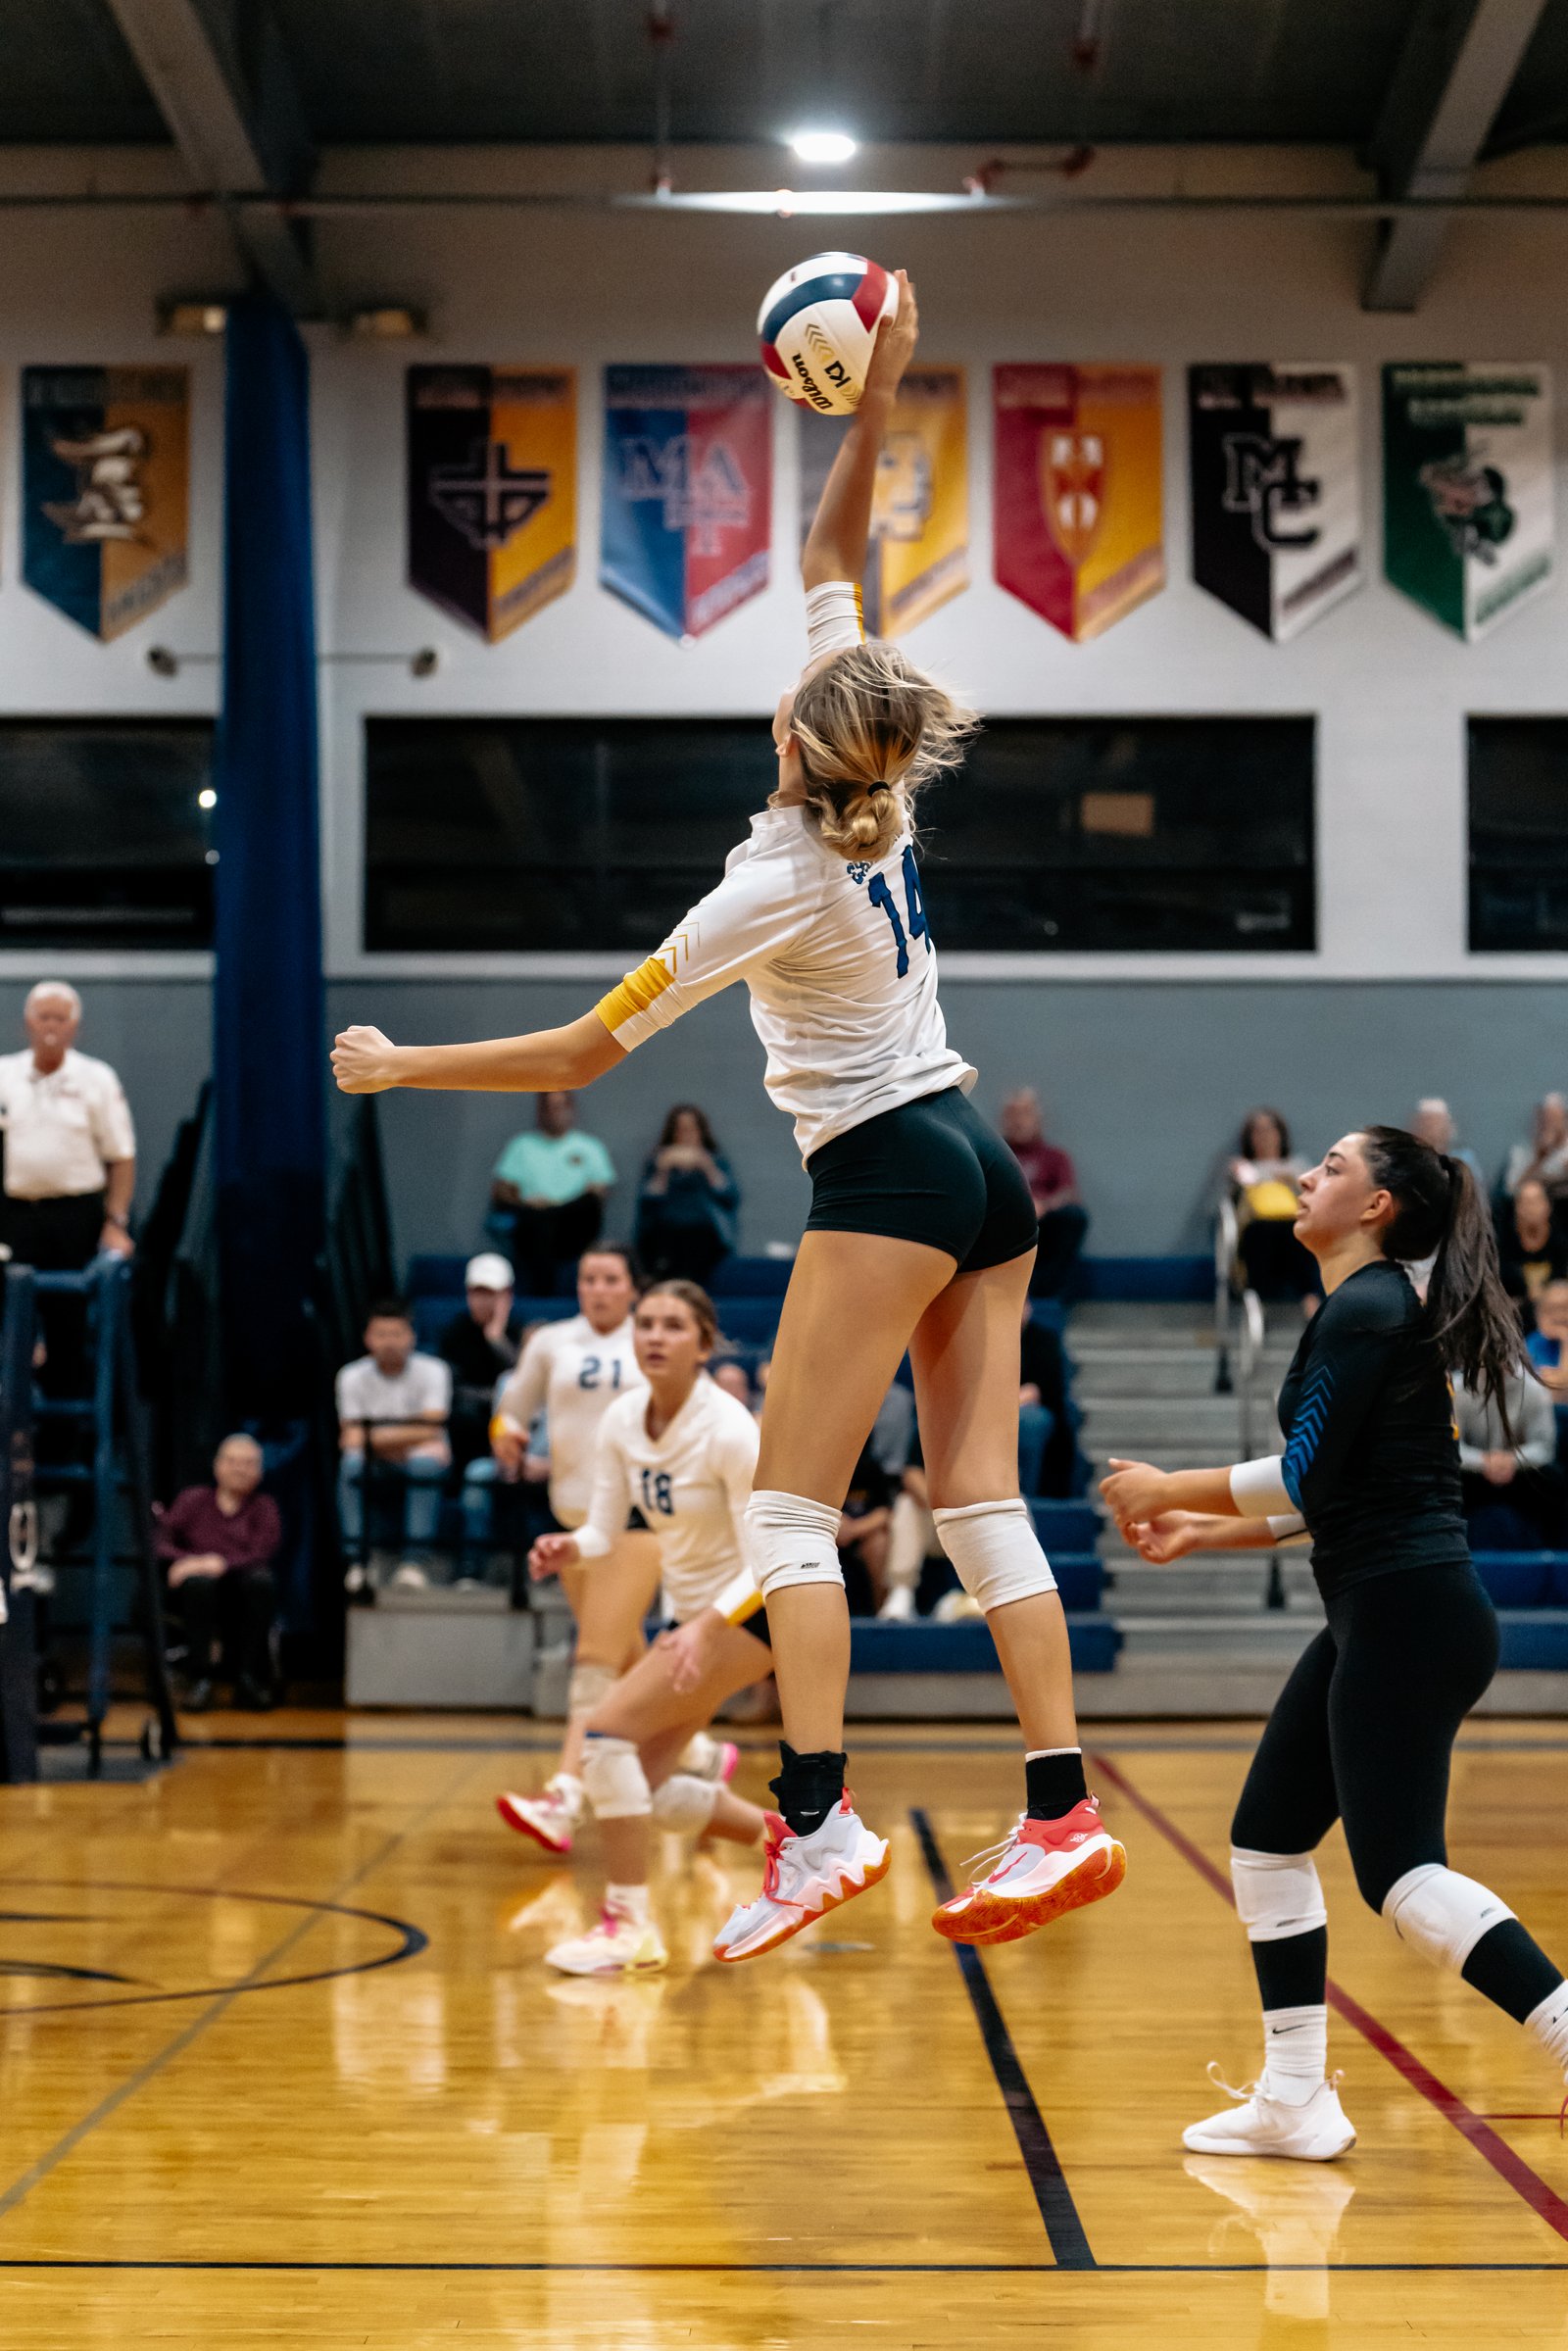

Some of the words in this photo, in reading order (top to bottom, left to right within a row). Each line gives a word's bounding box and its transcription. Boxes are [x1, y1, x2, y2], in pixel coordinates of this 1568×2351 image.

[792, 353, 833, 410] Wilson
[1222, 431, 1320, 550] MC
[868, 844, 931, 979] 14
[576, 1355, 622, 1390] 21
